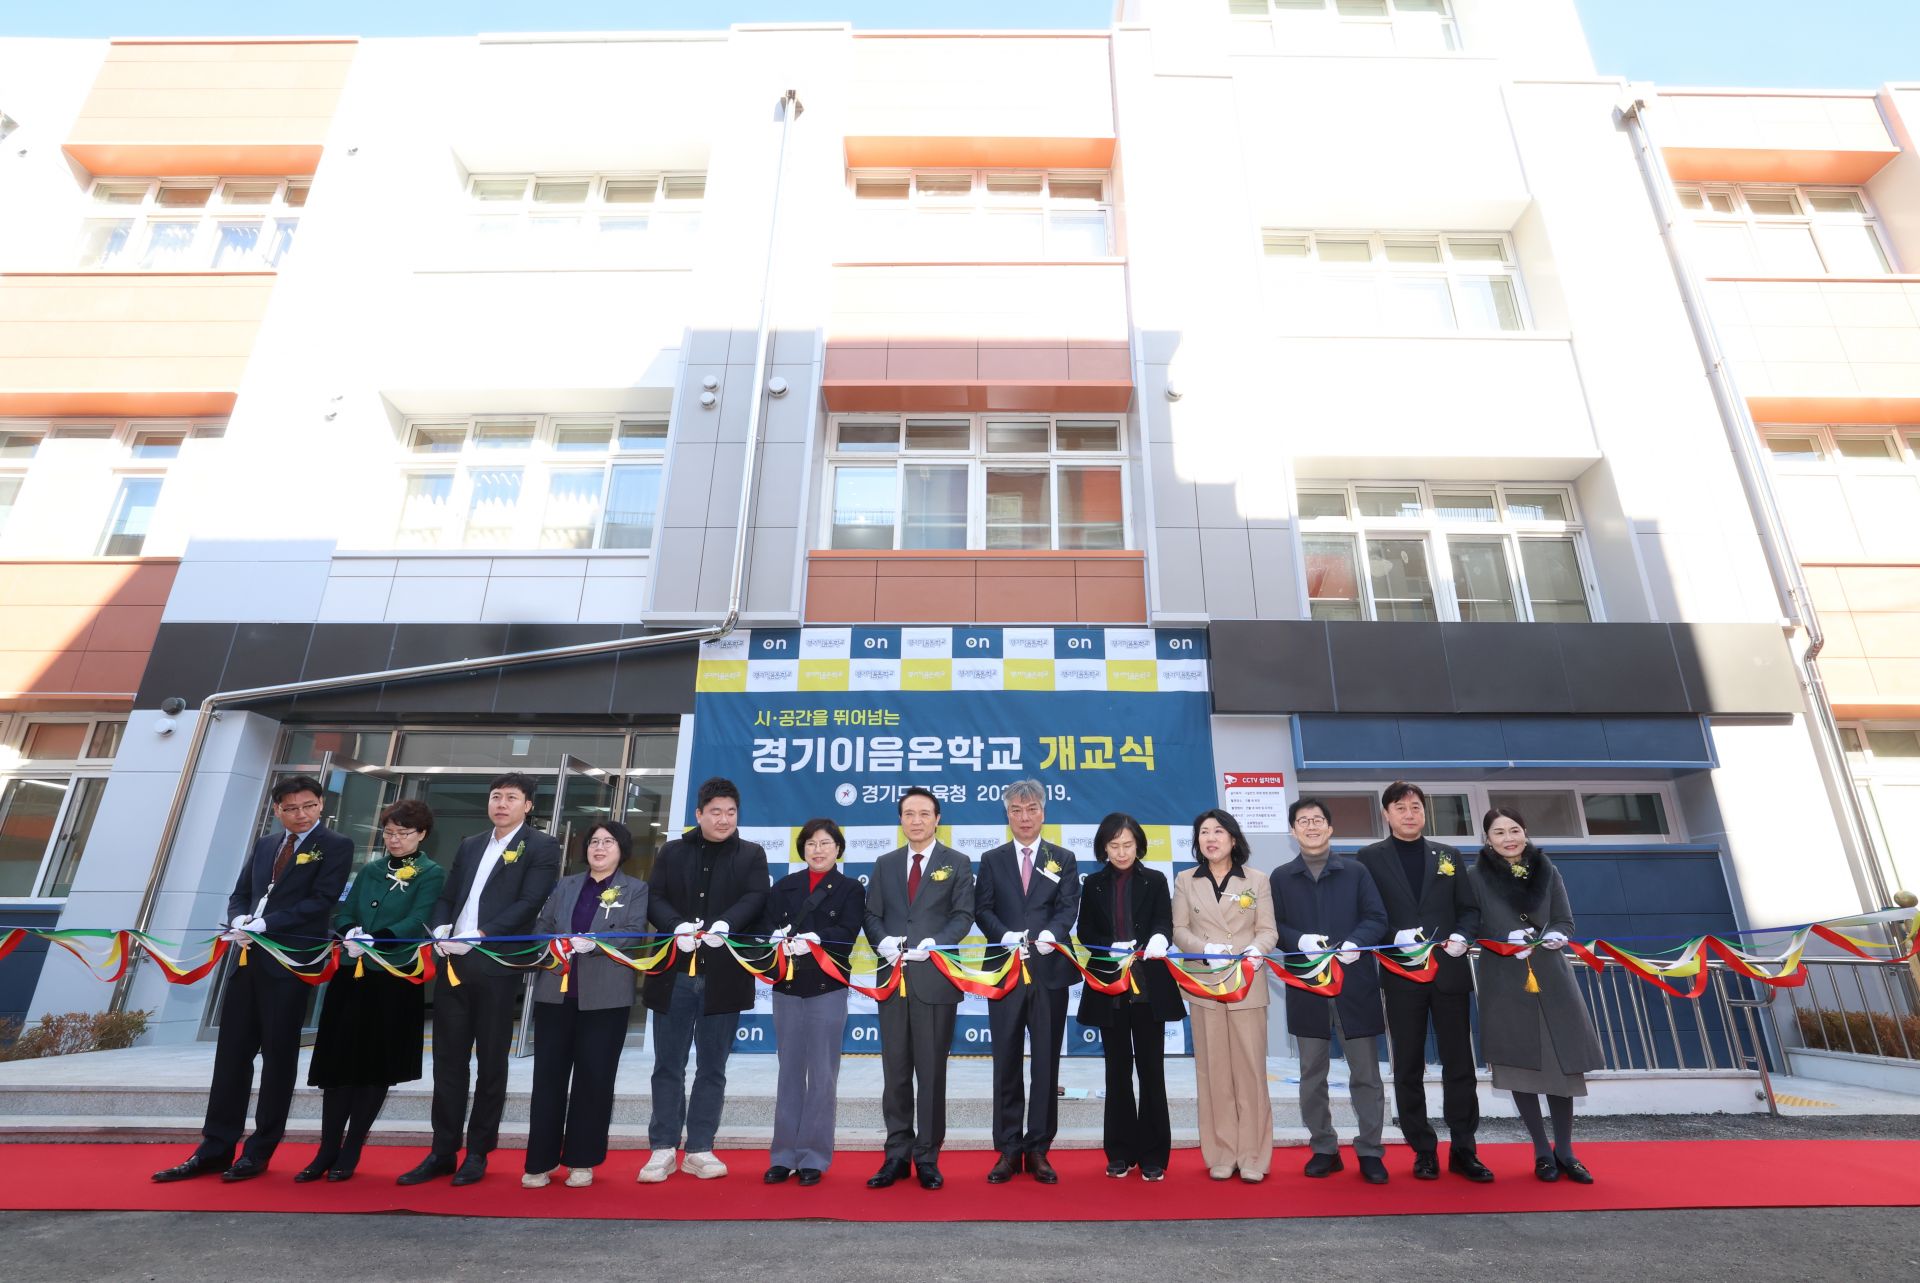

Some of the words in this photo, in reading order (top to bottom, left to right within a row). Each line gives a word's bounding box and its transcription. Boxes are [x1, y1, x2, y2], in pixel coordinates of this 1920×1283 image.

[762, 638, 787, 650] on
[864, 637, 888, 649] on
[965, 637, 990, 649] on
[1067, 637, 1092, 649] on
[1169, 638, 1193, 650] on
[833, 709, 901, 726] 뛰어넘는
[752, 736, 1023, 773] 경기이음온학교
[1039, 735, 1155, 771] 개교식
[736, 1026, 764, 1041] on
[851, 1026, 879, 1041] on
[965, 1028, 992, 1042] on
